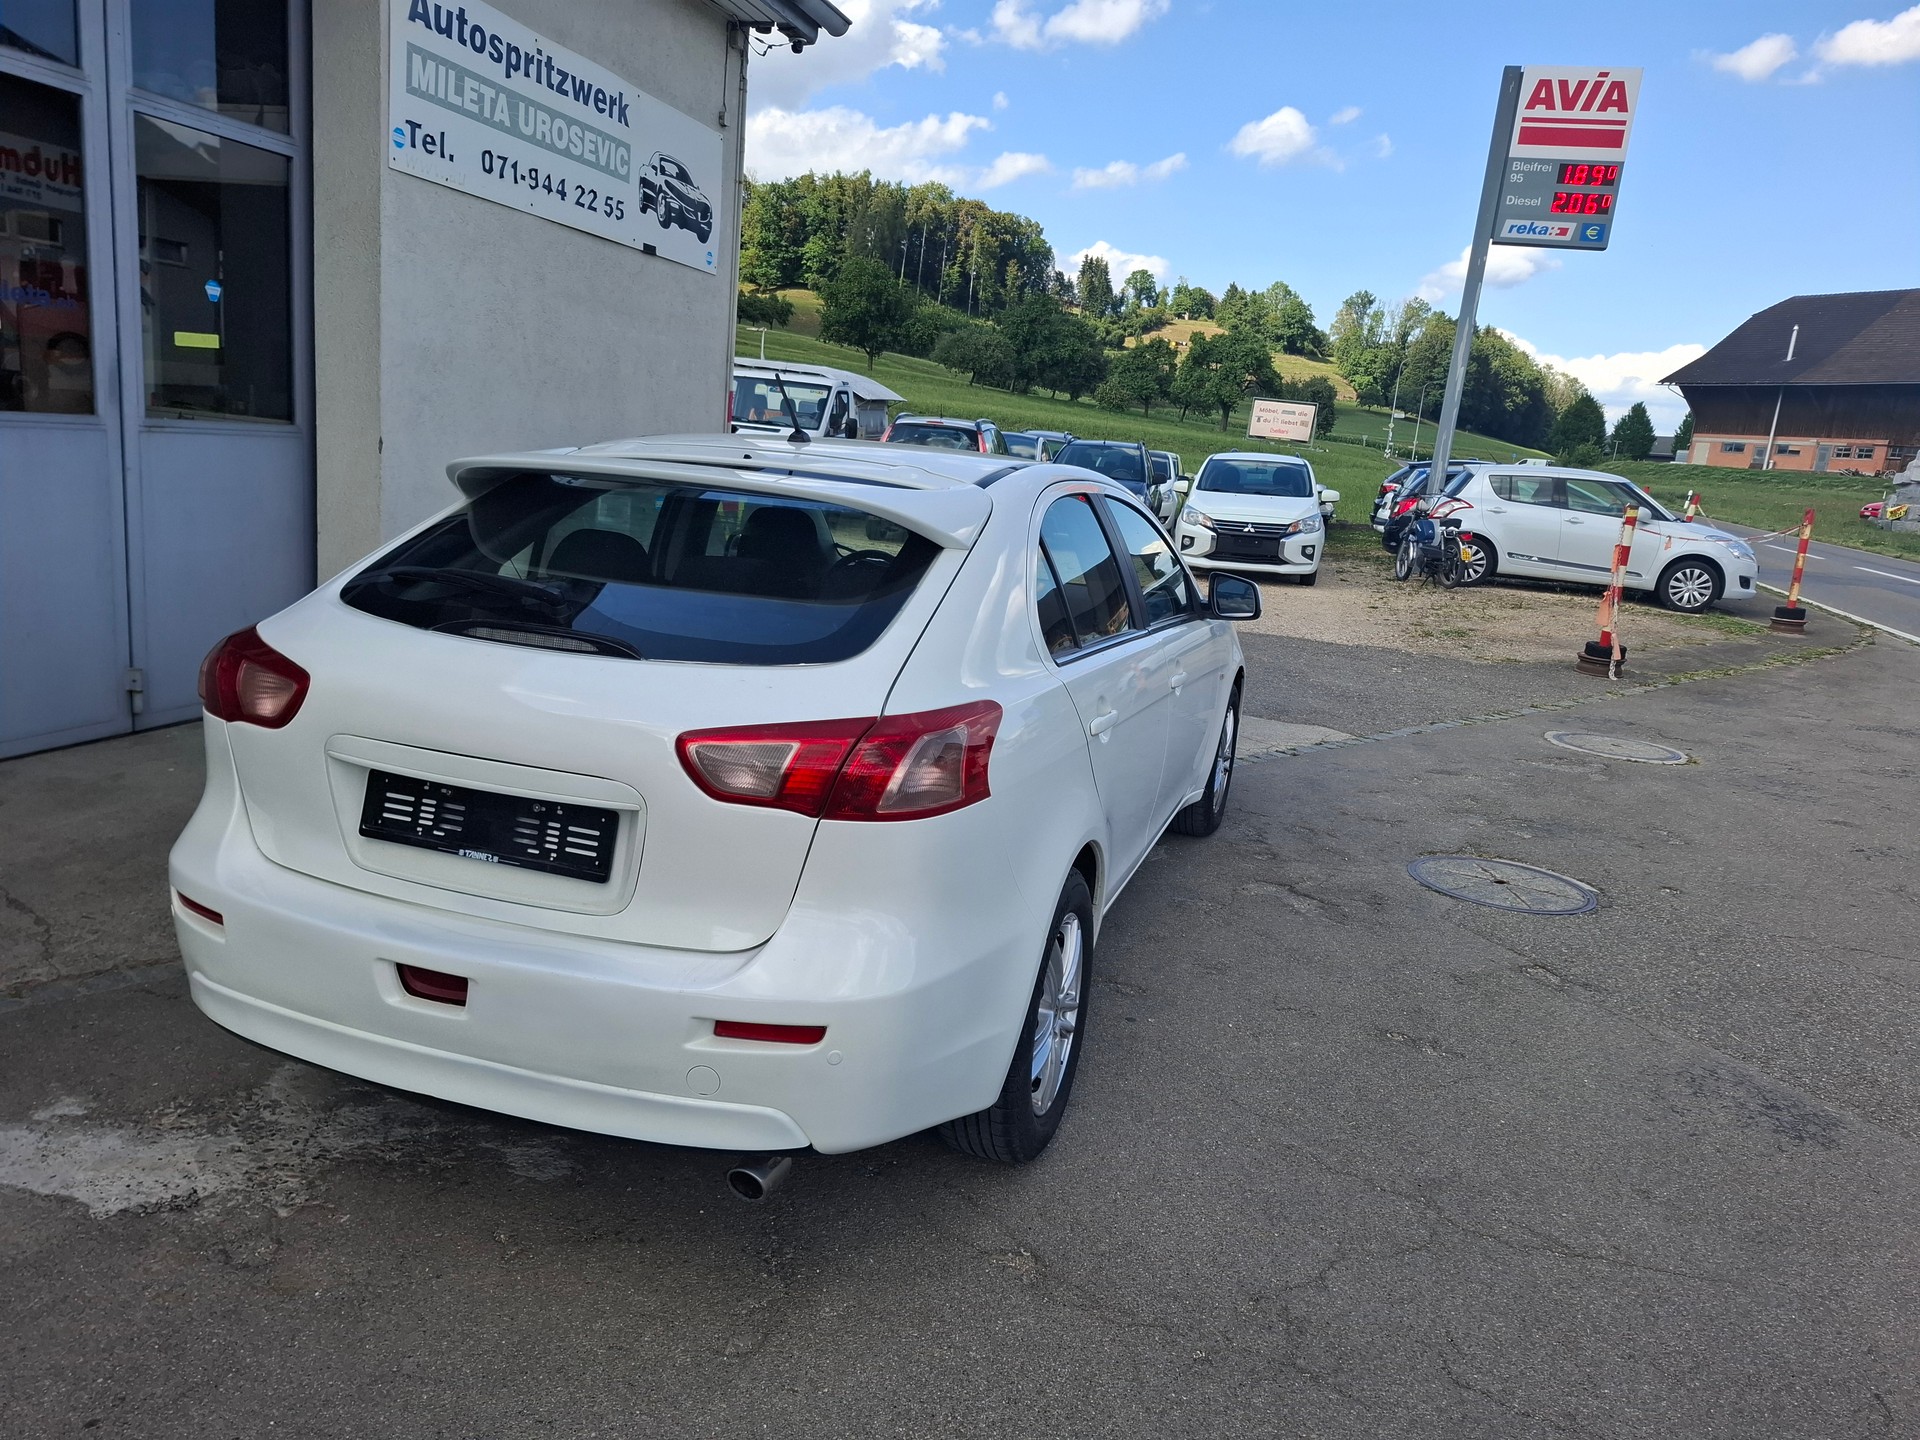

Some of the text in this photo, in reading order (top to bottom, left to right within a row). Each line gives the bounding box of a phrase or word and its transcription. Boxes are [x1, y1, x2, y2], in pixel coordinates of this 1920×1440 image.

[408, 0, 630, 128] Autospritzwerk
[1524, 71, 1628, 113] AVIA
[412, 53, 511, 127] MILETA
[518, 101, 629, 176] UROSEVIC
[405, 119, 455, 162] Tel.
[574, 184, 598, 213] 22
[603, 196, 625, 221] 55
[1510, 173, 1524, 182] 95
[1512, 161, 1553, 172] Bleifrei
[1506, 195, 1542, 206] Diesel
